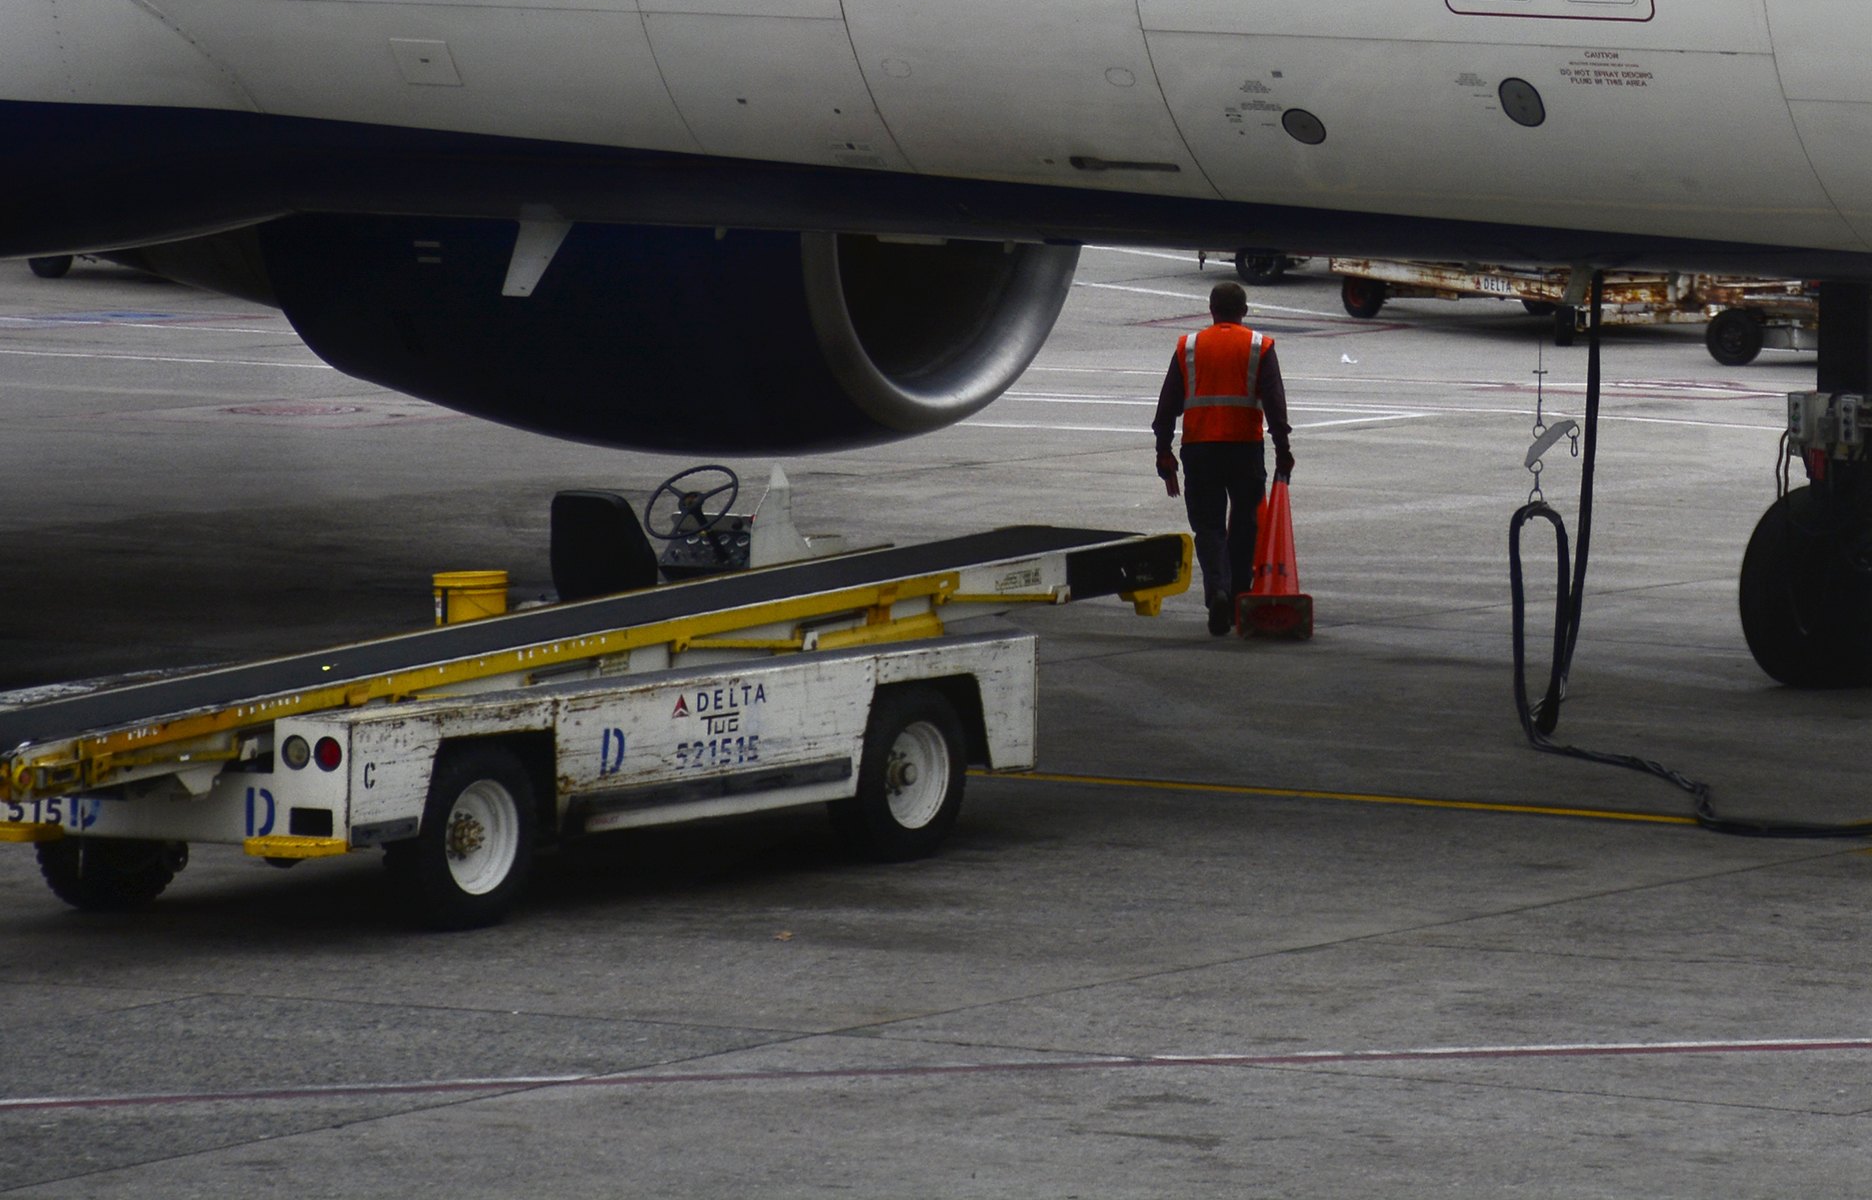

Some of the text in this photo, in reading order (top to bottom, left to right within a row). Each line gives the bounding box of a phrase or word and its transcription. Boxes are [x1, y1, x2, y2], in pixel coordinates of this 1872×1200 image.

[1584, 51, 1619, 59] CAUTION
[1560, 68, 1572, 76] DO
[1574, 69, 1590, 77] NOT
[1594, 70, 1619, 79] SPRAY
[1484, 277, 1511, 292] DELTA
[697, 684, 766, 712] DELTA
[701, 712, 741, 736] TUG
[600, 728, 625, 775] D
[676, 735, 760, 770] 521515
[364, 762, 376, 789] C
[246, 787, 275, 837] D
